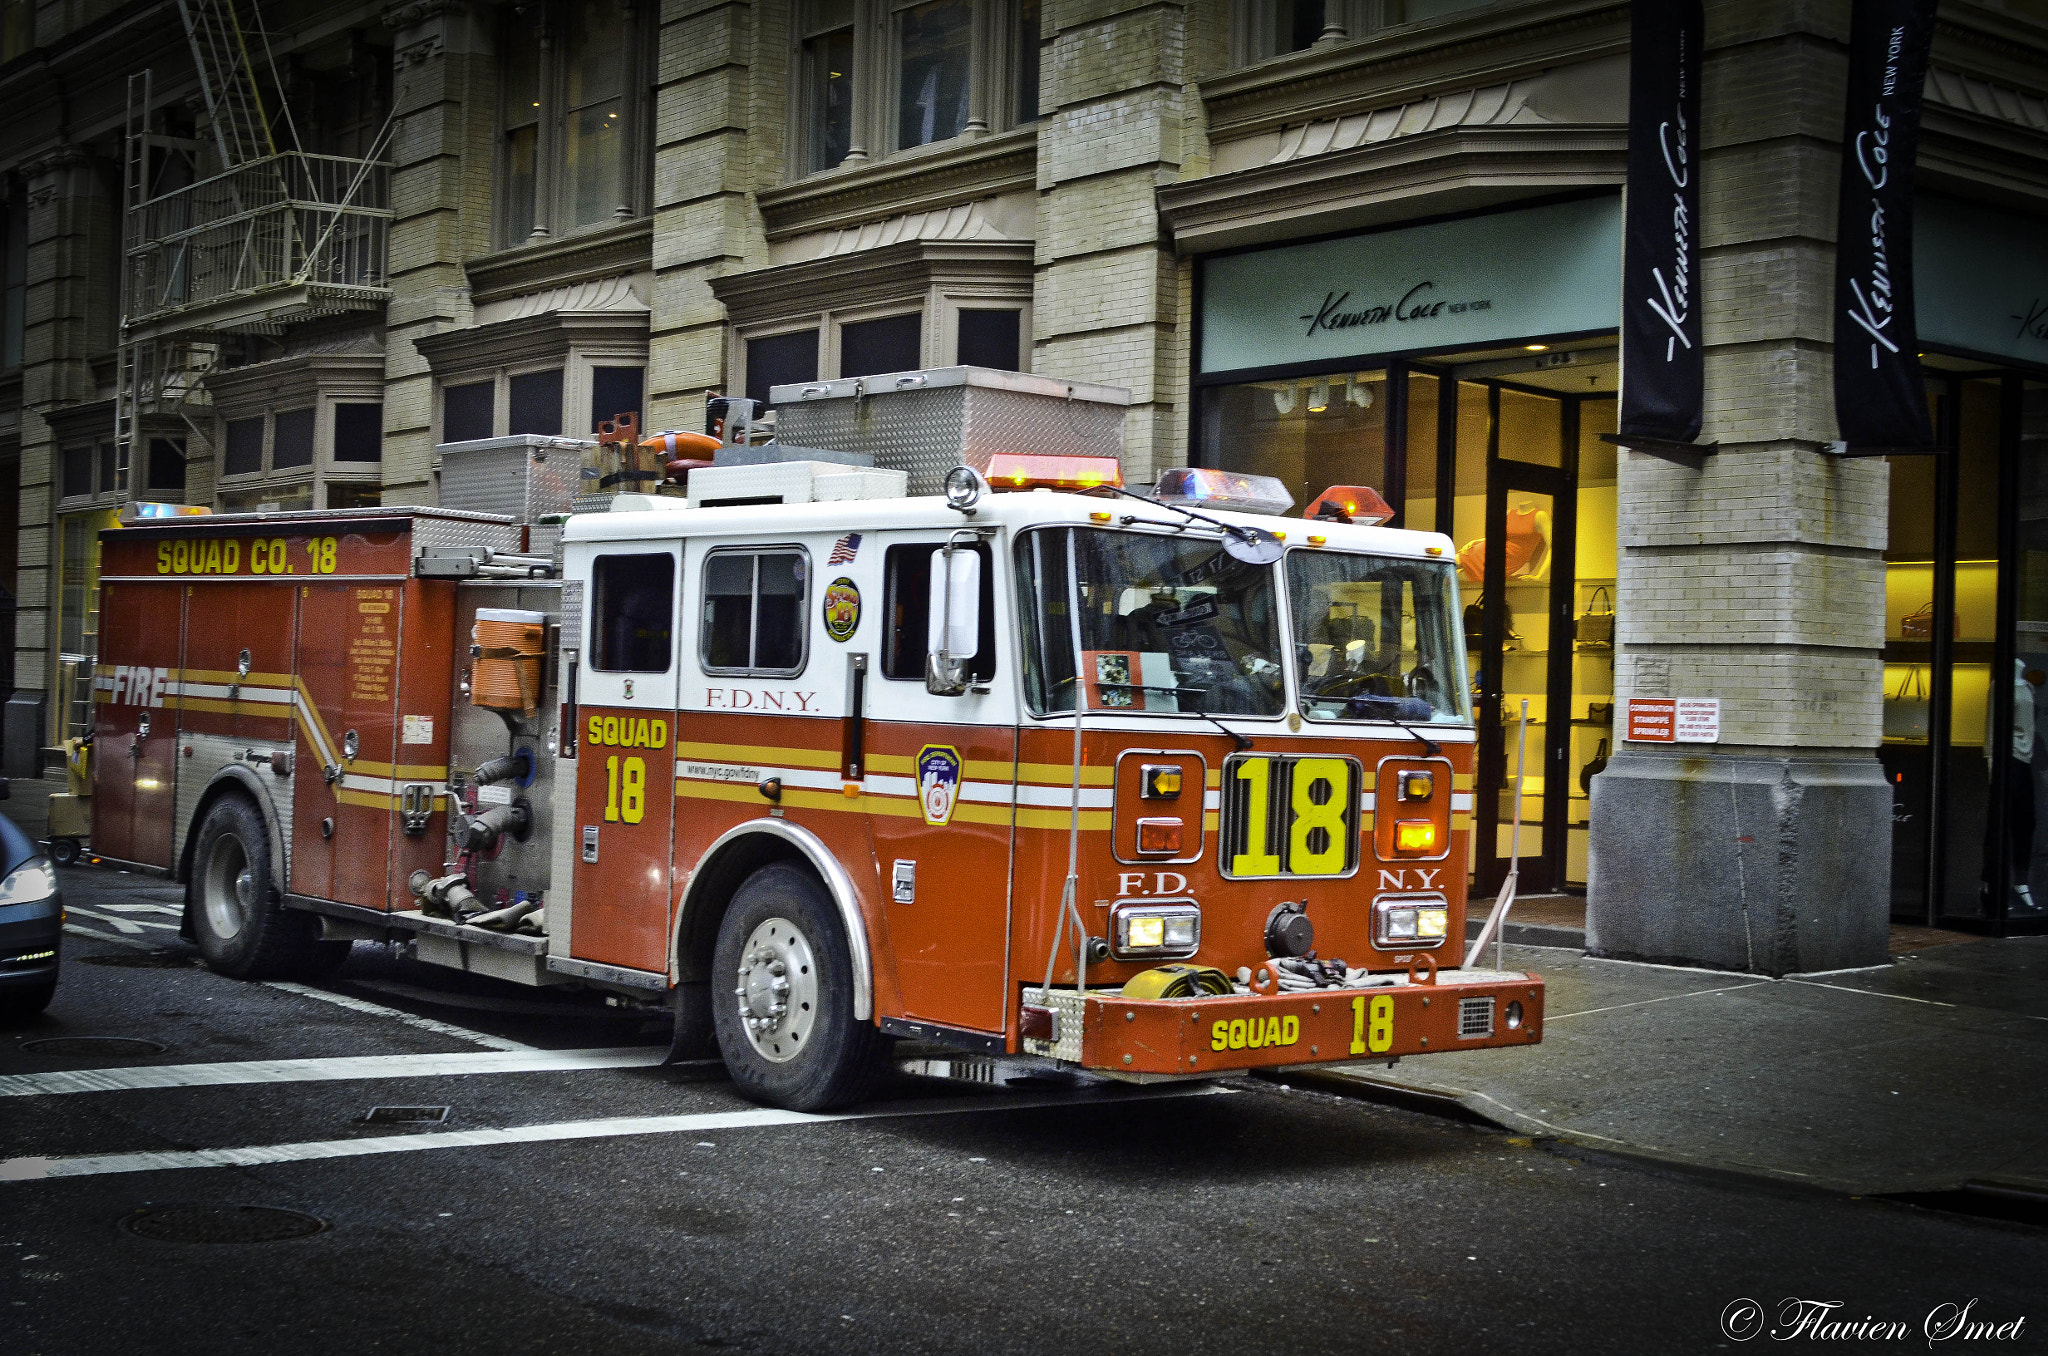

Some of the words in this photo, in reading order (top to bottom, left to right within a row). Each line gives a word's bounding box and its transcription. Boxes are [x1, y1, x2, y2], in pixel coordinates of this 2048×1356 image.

[1886, 26, 1904, 63] YORK
[1882, 66, 1898, 96] NEW
[156, 539, 241, 575] SQUAD
[250, 538, 294, 575] CO.
[306, 536, 338, 574] 18
[110, 665, 169, 708] FIRE
[705, 687, 821, 712] F.D.N.Y.
[588, 715, 668, 750] SQUAD
[604, 755, 647, 825] 18
[1231, 757, 1350, 877] 18
[1115, 872, 1195, 896] F.D.
[1376, 867, 1446, 890] N.Y.
[1210, 1015, 1300, 1052] SQUAD
[1349, 994, 1396, 1055] 18
